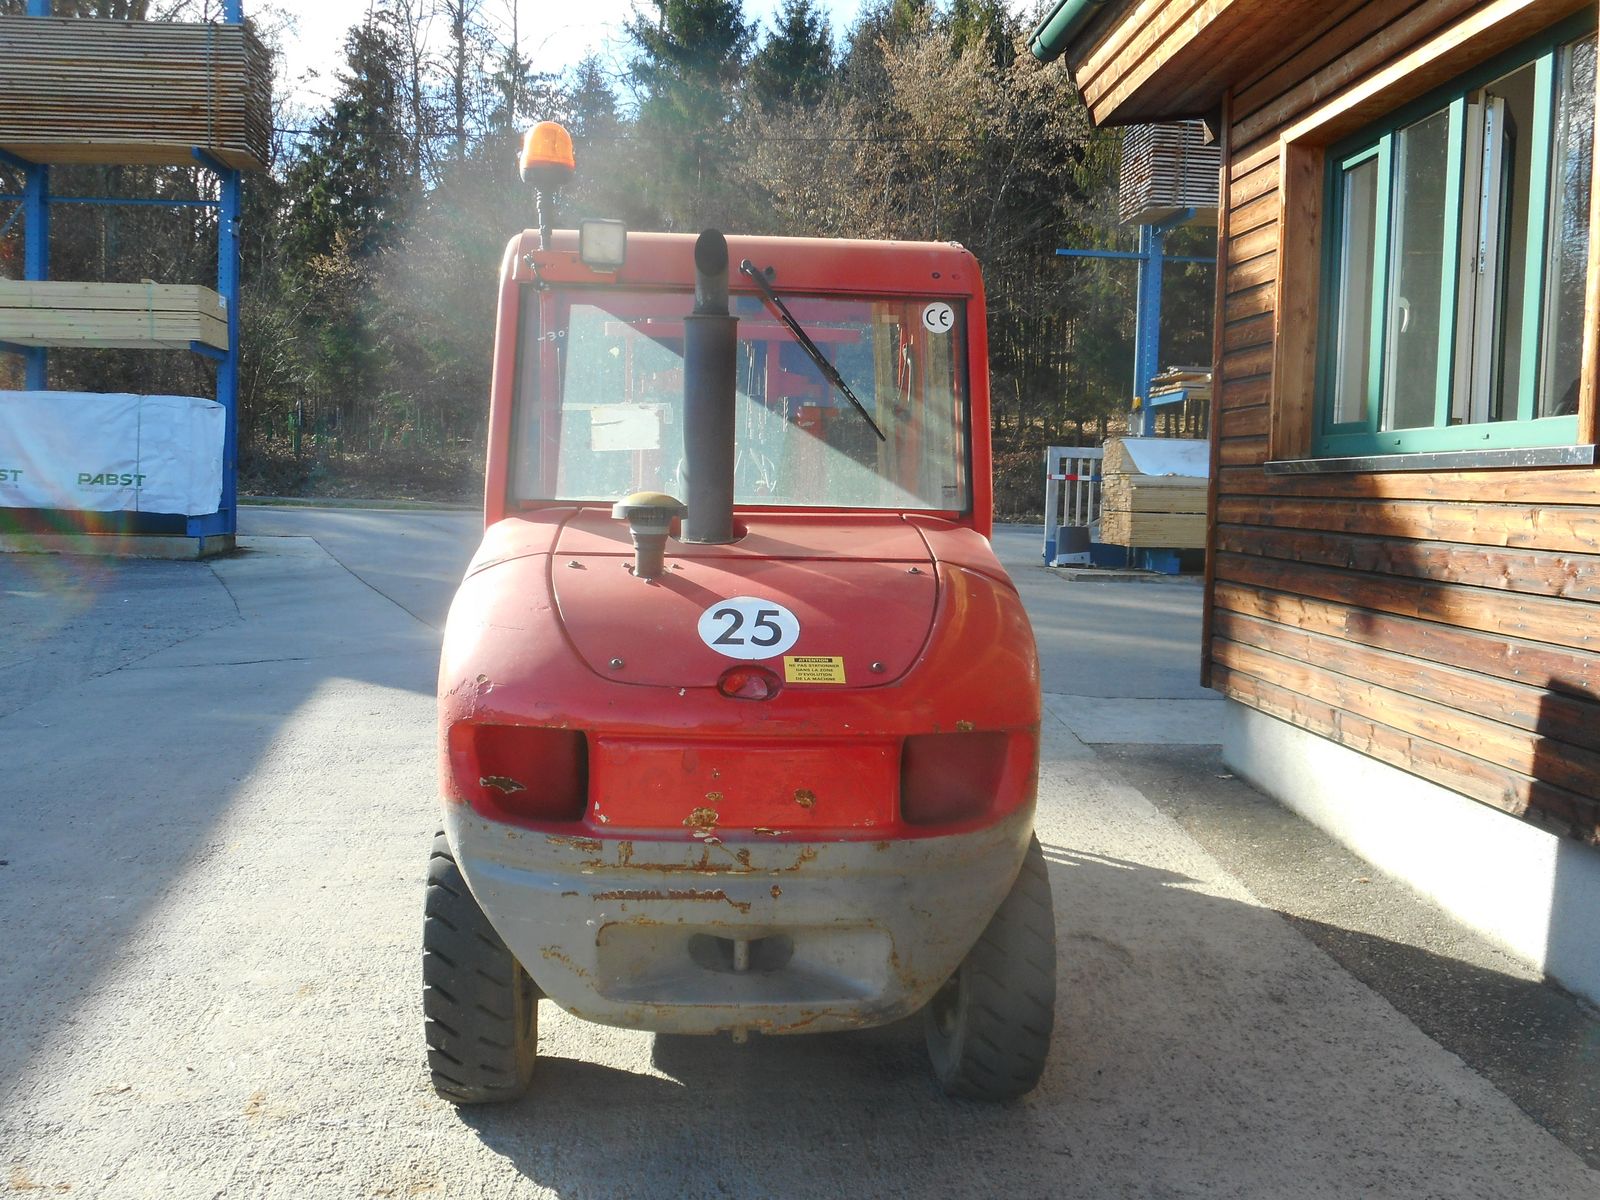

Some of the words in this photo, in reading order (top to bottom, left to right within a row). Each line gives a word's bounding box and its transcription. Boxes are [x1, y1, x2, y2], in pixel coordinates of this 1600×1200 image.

[926, 308, 949, 327] CE
[77, 472, 147, 487] PABST
[712, 608, 782, 647] 25
